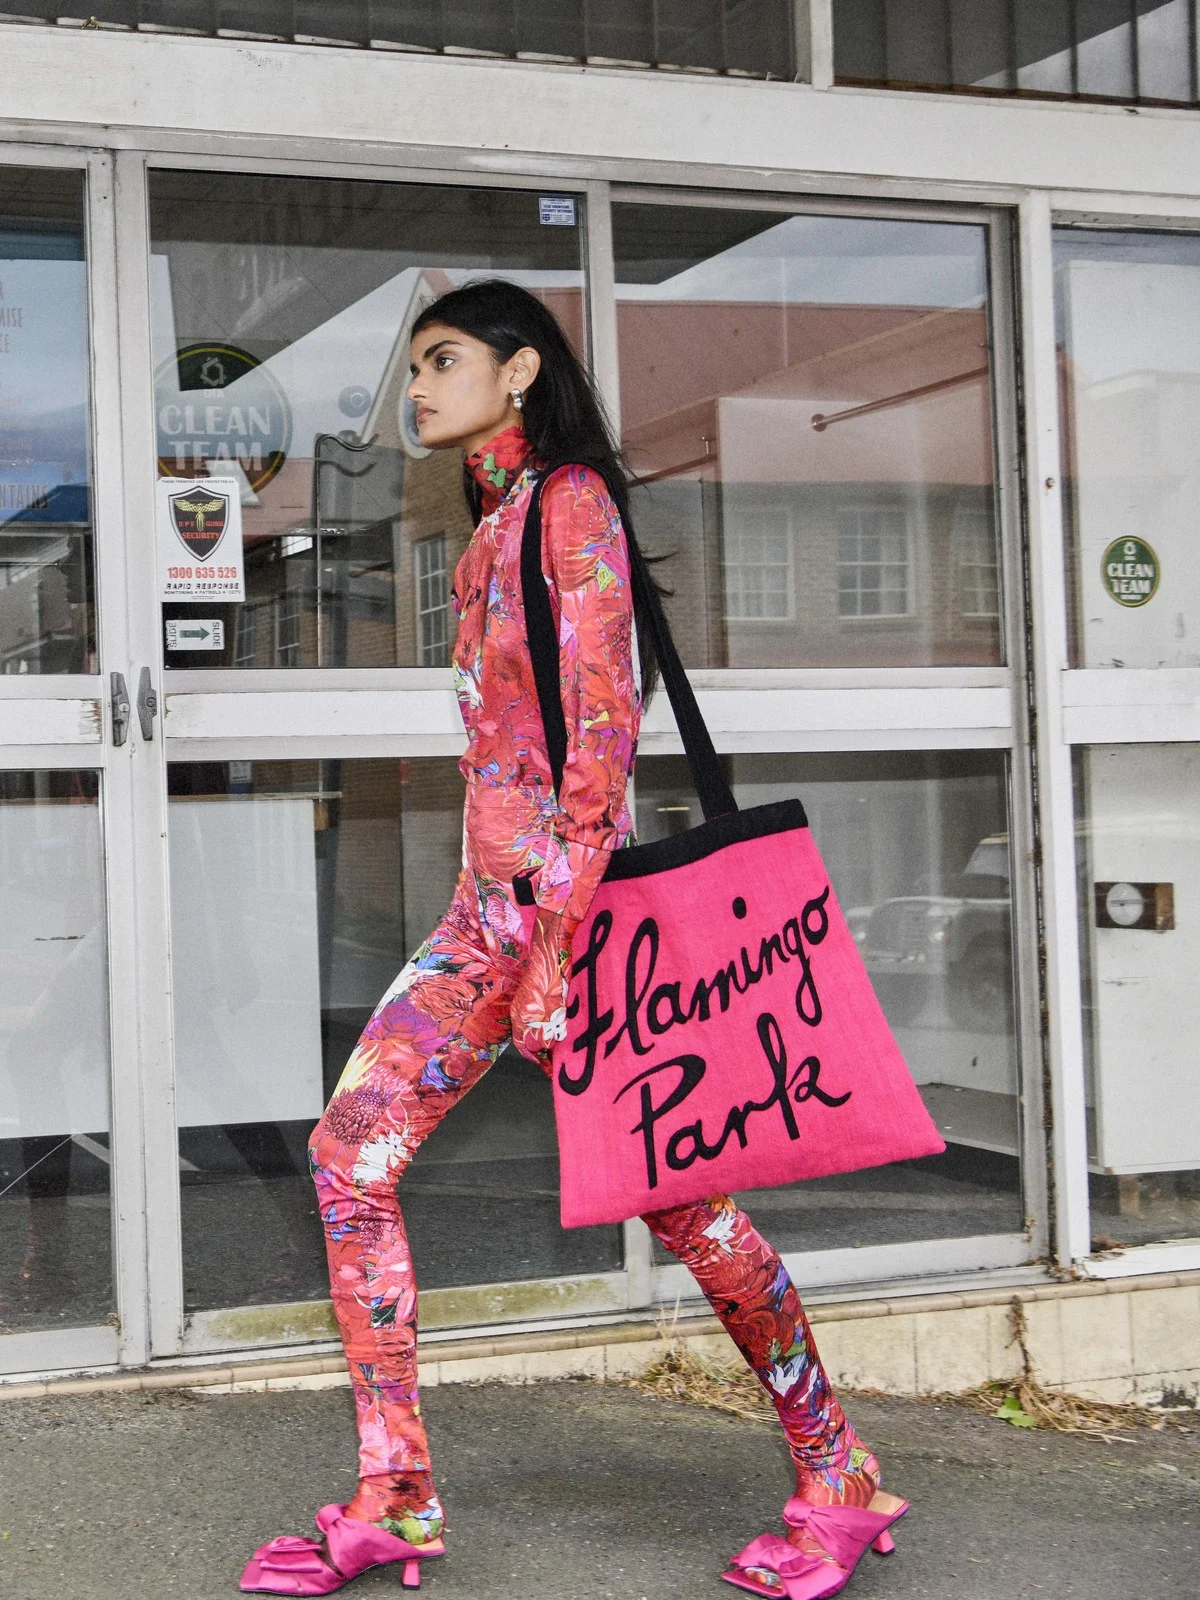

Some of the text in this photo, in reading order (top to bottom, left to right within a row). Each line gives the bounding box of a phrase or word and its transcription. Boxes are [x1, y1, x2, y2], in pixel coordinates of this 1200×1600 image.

[159, 404, 271, 436] CLEAN
[168, 440, 263, 472] TEAM
[167, 566, 237, 579] 1300 635 526
[1107, 563, 1154, 578] CLEAN
[1110, 579, 1151, 594] TEAM
[169, 622, 178, 648] SLIDE
[212, 621, 221, 648] SLIDE
[558, 885, 830, 1096] Flamingo
[613, 1012, 852, 1190] Park
